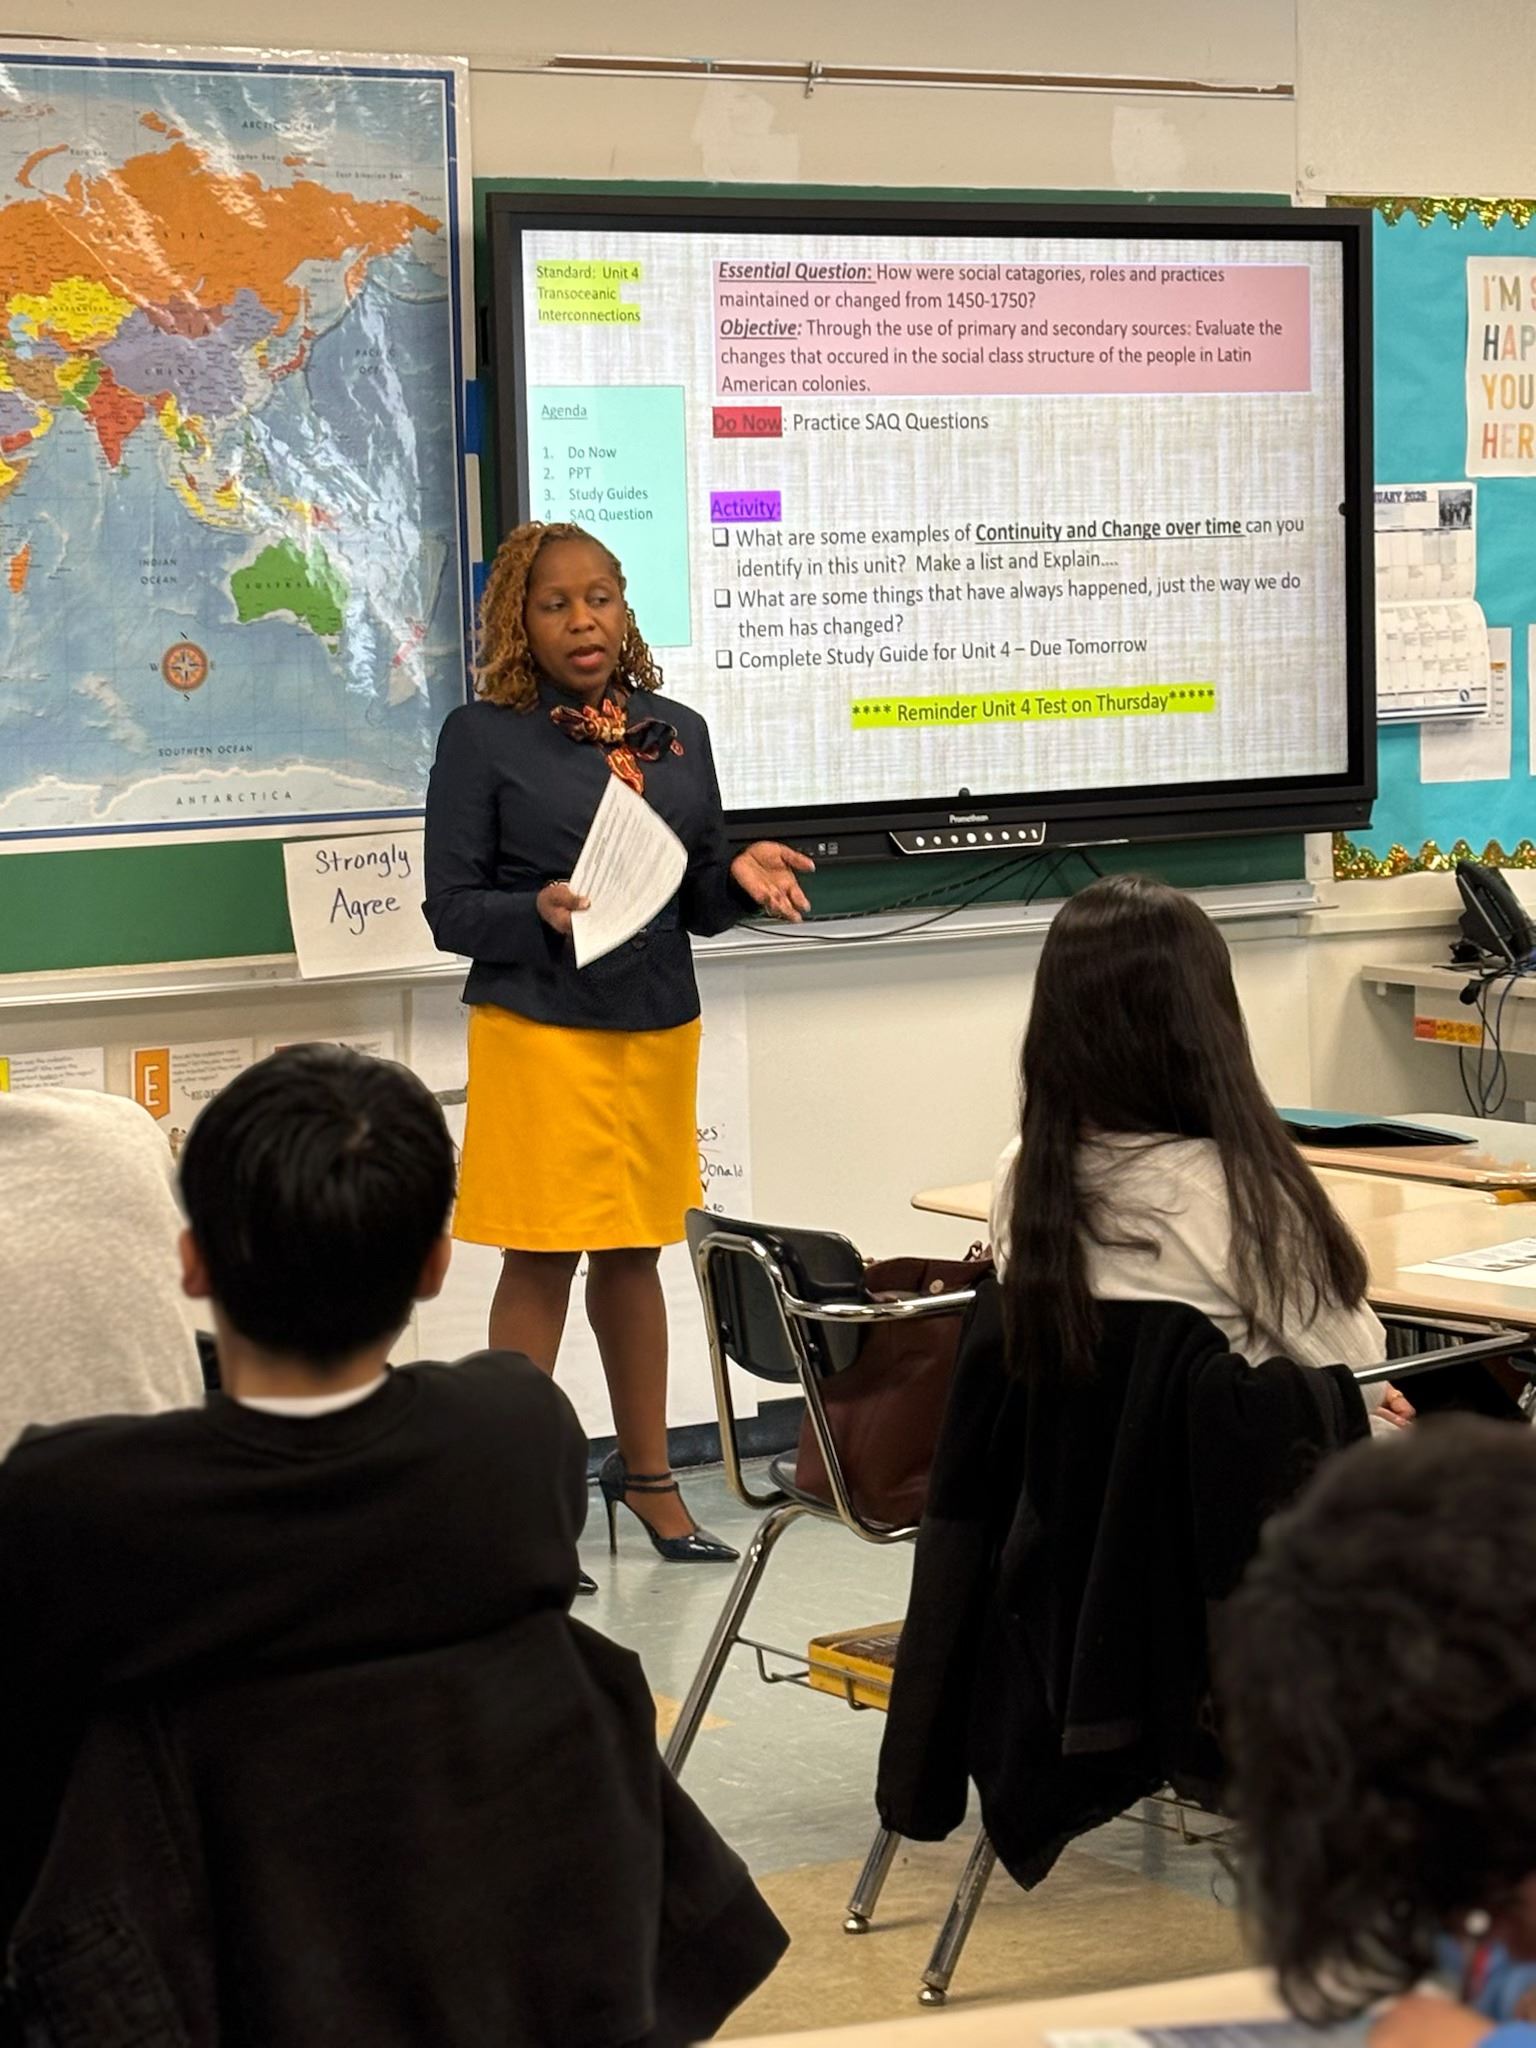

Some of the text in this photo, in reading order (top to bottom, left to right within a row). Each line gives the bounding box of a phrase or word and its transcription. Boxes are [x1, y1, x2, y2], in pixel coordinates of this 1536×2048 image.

[536, 265, 640, 281] Standard: Unit 4
[718, 261, 1225, 287] Essential Question: How were social catagories, roles and practices
[537, 286, 617, 301] Transoceanic
[719, 290, 1037, 313] maintained or changed from 1450-1750?
[1483, 275, 1522, 313] I'M
[538, 308, 641, 323] Interconnections
[720, 319, 1283, 342] Objective: Through the use of primary and secondary sources: Evaluate the
[1483, 324, 1536, 362] HAP
[720, 346, 1252, 369] changes that occured in the social class structure of the people in Latin
[721, 374, 871, 392] American colonies.
[1481, 374, 1535, 411] YOU
[541, 404, 588, 419] Agenda
[713, 414, 737, 433] Do
[793, 412, 860, 431] Practice
[865, 413, 901, 433] SAQ
[905, 411, 989, 431] Questions
[543, 446, 617, 459] 1. Do Now
[1482, 422, 1536, 460] HER
[543, 466, 592, 480] 2. PPT
[544, 486, 649, 503] 3. Study Guides
[569, 508, 596, 522] SAQ
[599, 508, 653, 522] Question
[711, 499, 781, 520] Activity:
[736, 517, 1304, 547] What are some examples of Continuity and Change over time can you
[138, 558, 178, 568] INDIAN
[737, 558, 802, 579] identify
[808, 557, 823, 576] in
[827, 556, 859, 575] this
[863, 554, 906, 574] unit?
[916, 553, 961, 572] Make
[966, 556, 975, 571] a
[980, 551, 1003, 570] list
[1008, 551, 1038, 569] and
[140, 576, 178, 585] OCEAN
[738, 572, 1301, 608] What are some things that have always happened, just the way we do
[738, 614, 904, 638] them has changed?
[739, 649, 822, 671] Complete
[826, 646, 875, 668] Study
[879, 644, 929, 663] Guide
[933, 643, 956, 660] for
[961, 641, 996, 659] Unit
[1000, 641, 1010, 658] 4
[1029, 639, 1062, 657] Due
[1066, 636, 1148, 655] Tomorrow
[897, 701, 976, 722] Reminder
[982, 698, 1017, 717] Unit
[1020, 697, 1031, 715] 4
[1035, 695, 1068, 714] Test
[1071, 699, 1092, 712] on
[158, 744, 253, 757] SOUTHERN OCEAN
[176, 791, 292, 806] ANTARCTICA
[316, 843, 411, 879] Strongly
[330, 887, 401, 935] Agree
[144, 1064, 160, 1107] E
